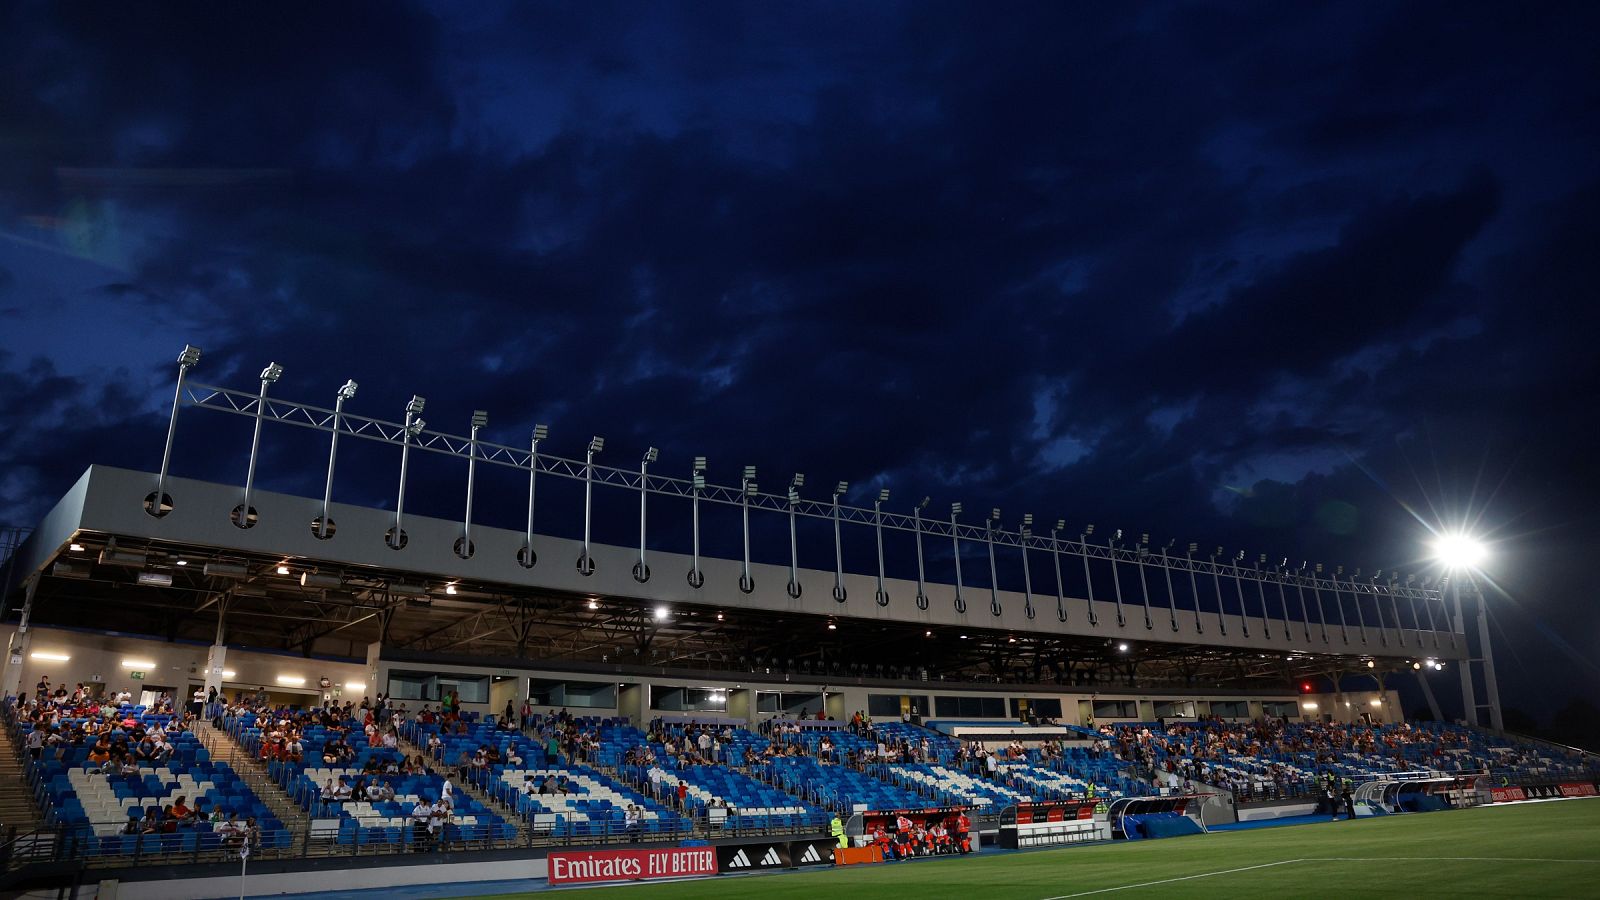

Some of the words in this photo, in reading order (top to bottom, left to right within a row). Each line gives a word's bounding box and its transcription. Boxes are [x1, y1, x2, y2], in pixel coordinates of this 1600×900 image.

[552, 855, 641, 879] Emirates
[649, 853, 668, 875] FLY
[672, 851, 713, 873] BETTER
